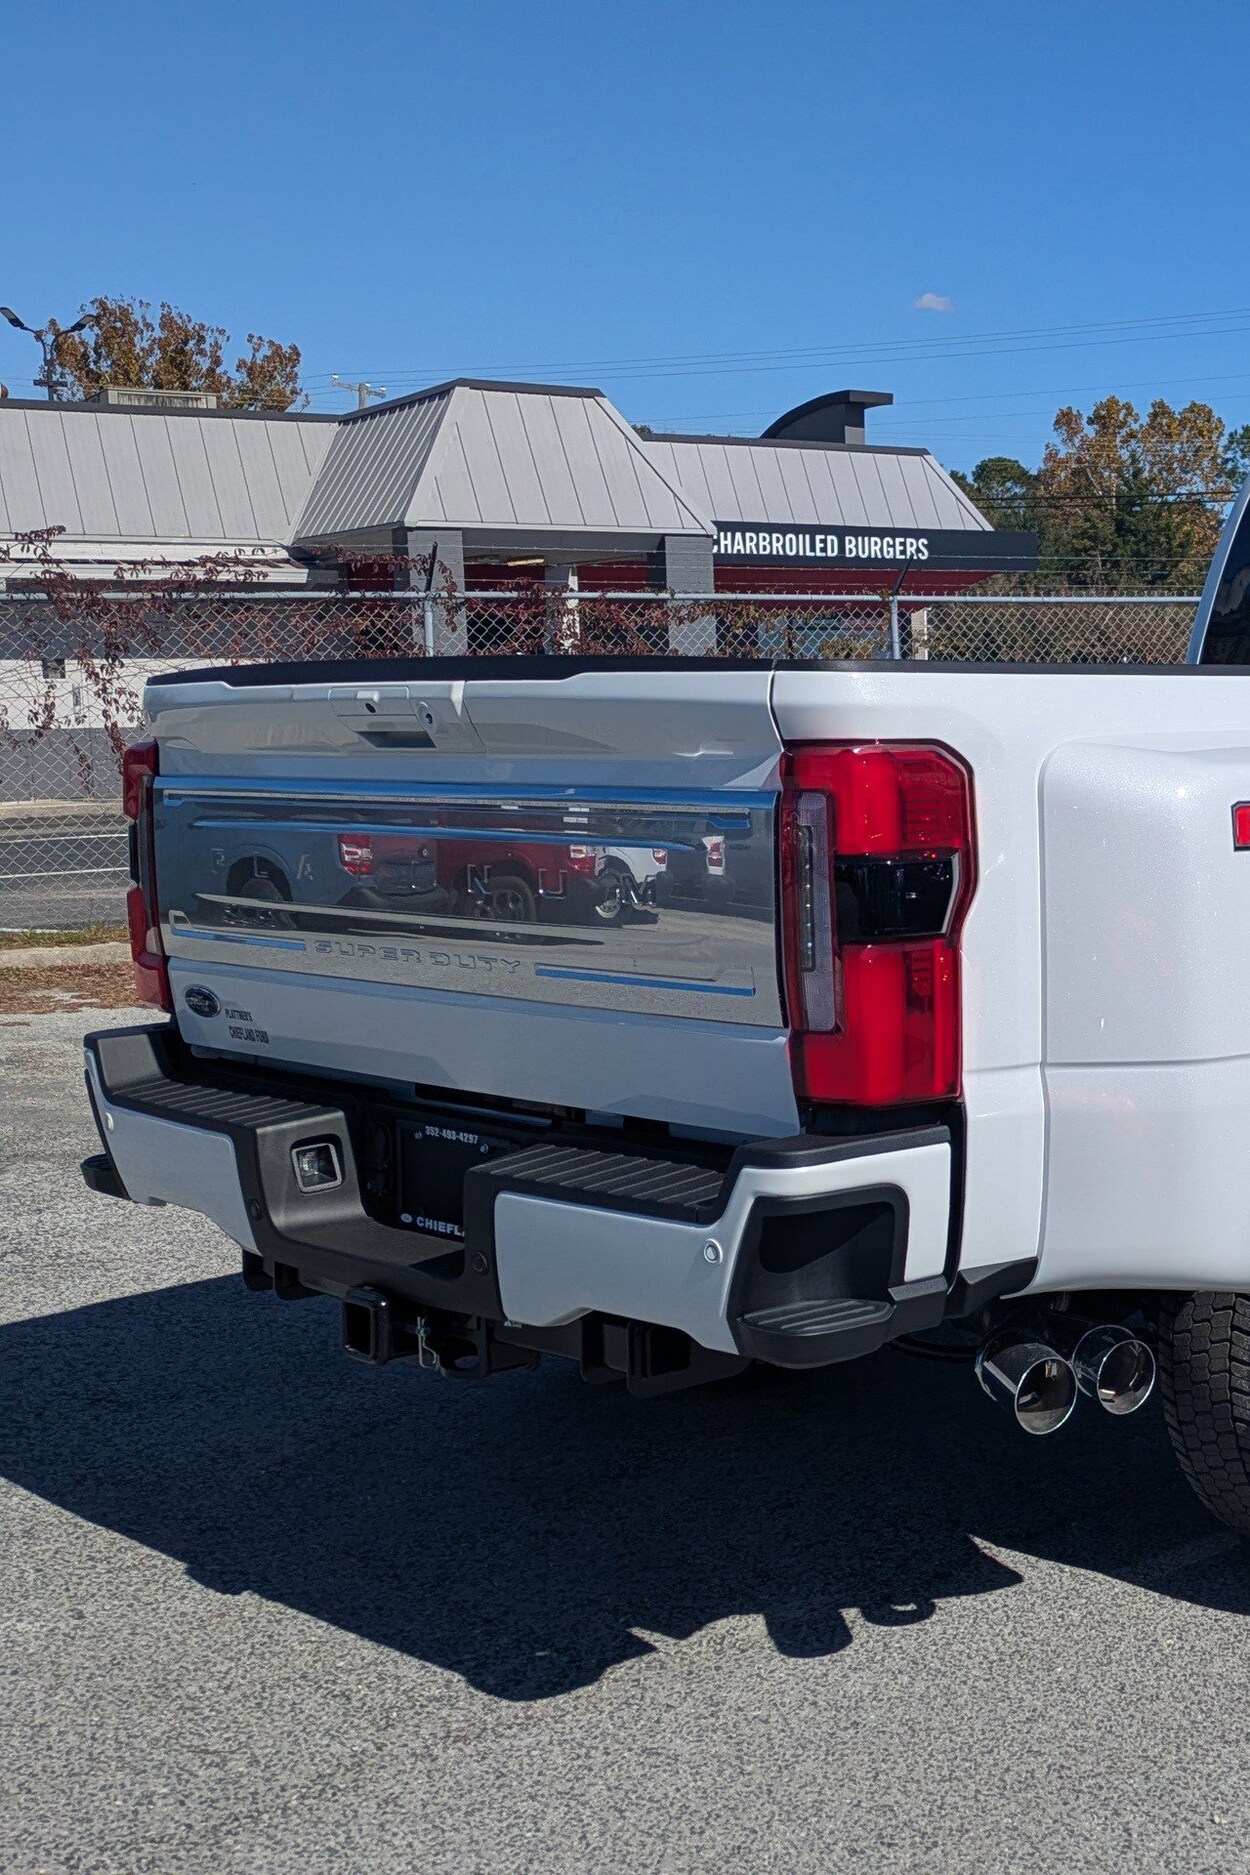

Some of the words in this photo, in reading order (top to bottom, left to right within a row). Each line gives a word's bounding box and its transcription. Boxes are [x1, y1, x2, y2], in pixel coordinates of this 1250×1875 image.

[845, 536, 929, 560] BURGERS
[313, 939, 421, 964] SUPER
[430, 951, 522, 974] DUTY
[425, 1125, 479, 1145] 352-493-4297
[416, 1216, 465, 1237] CHIEFL
